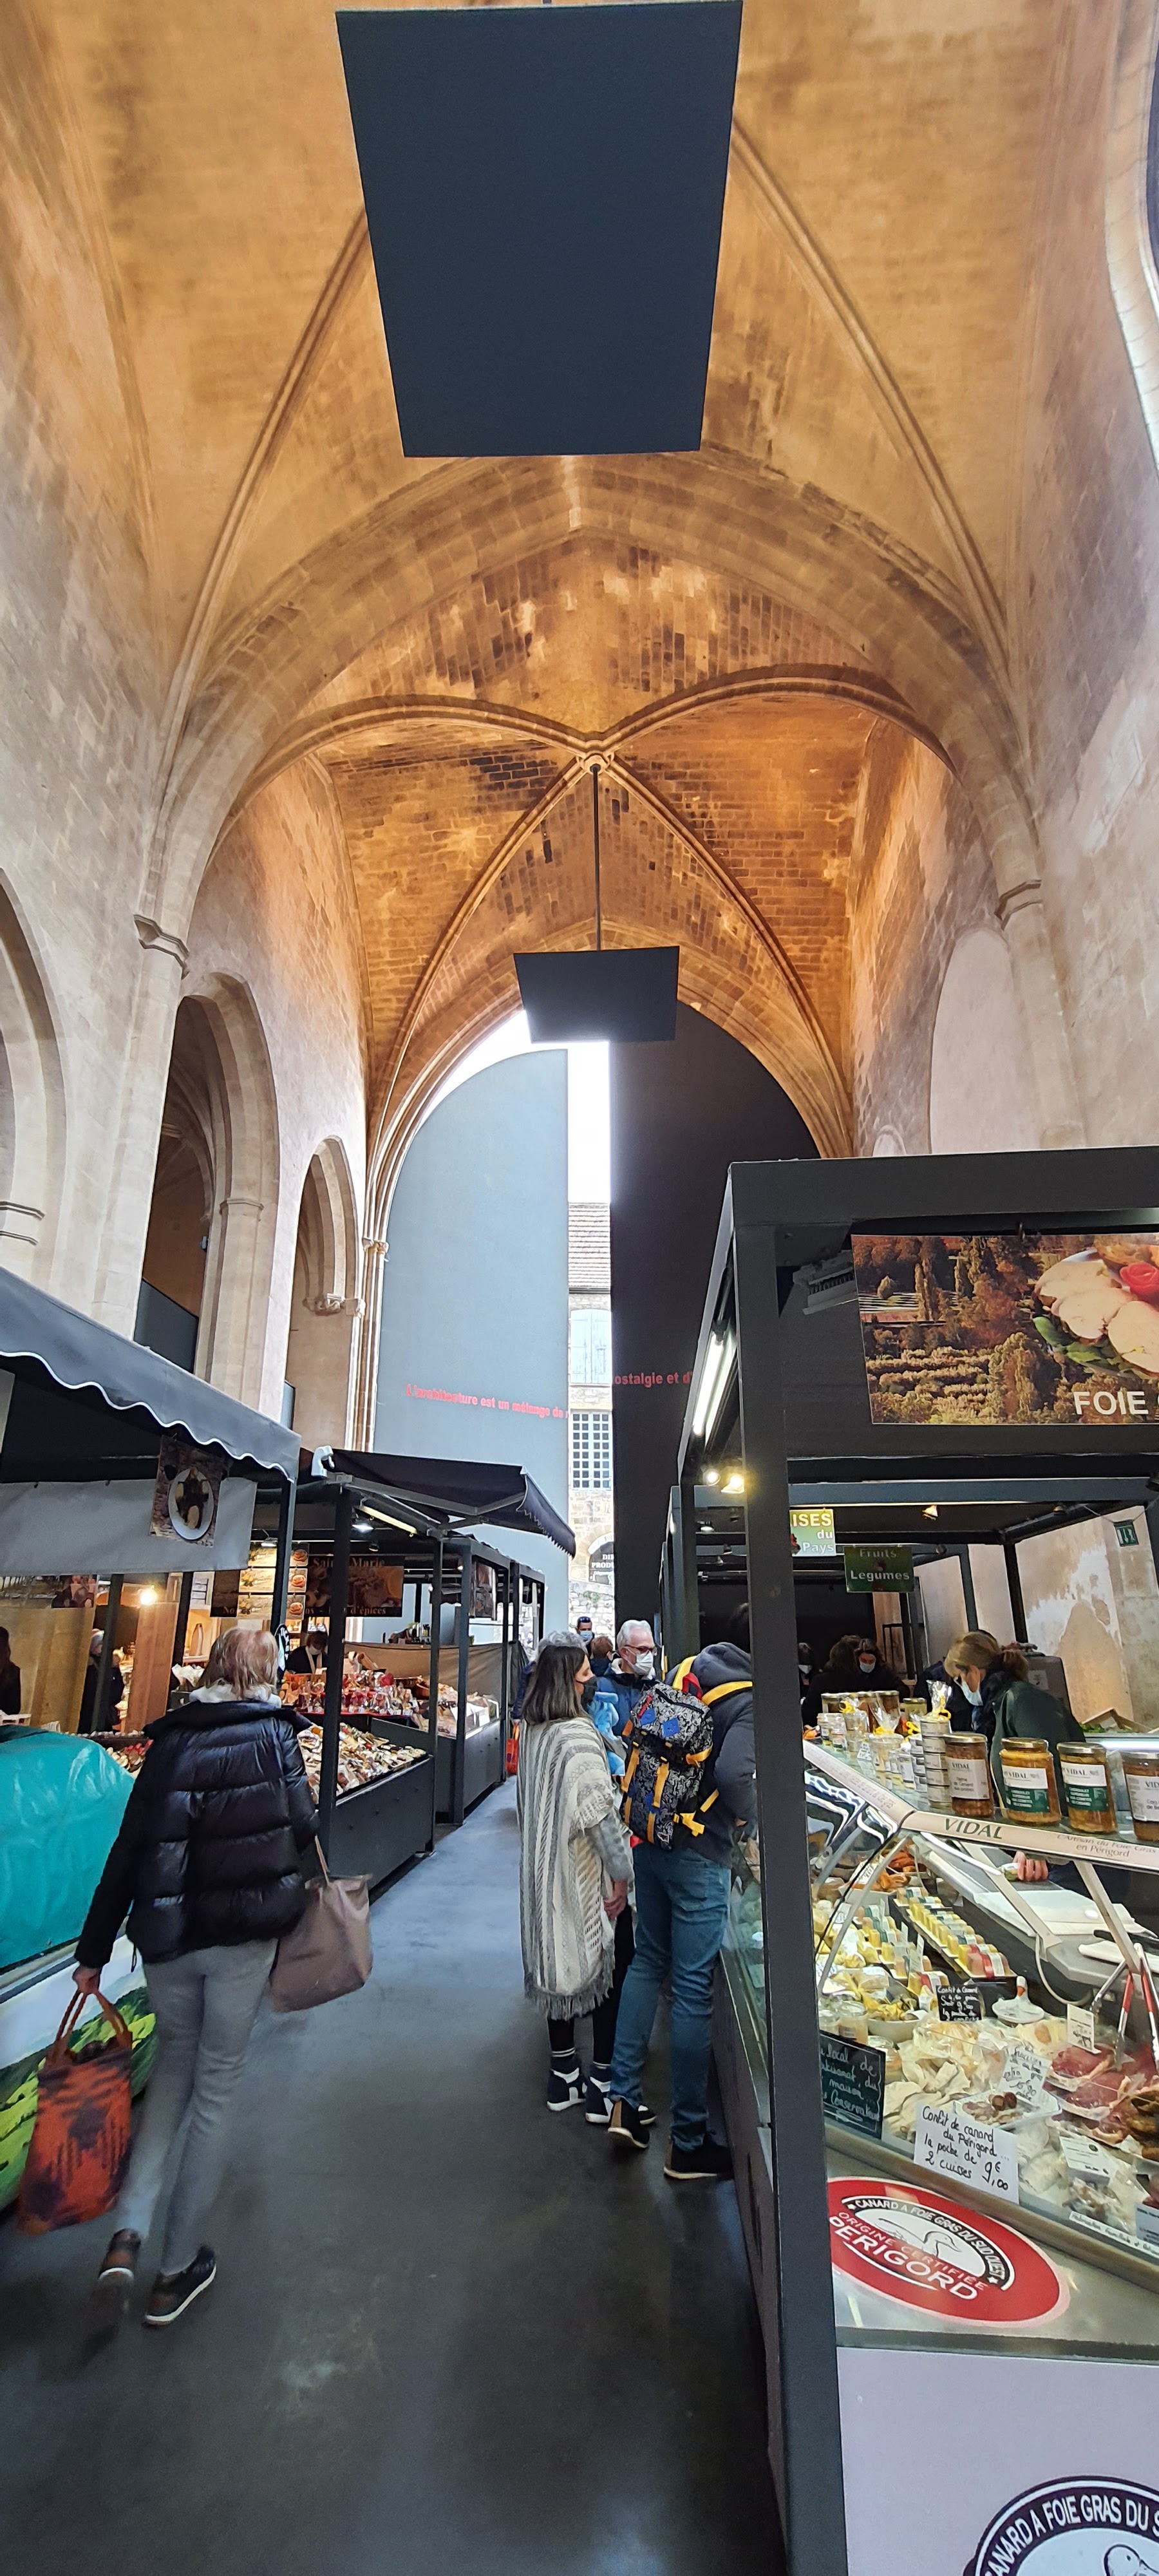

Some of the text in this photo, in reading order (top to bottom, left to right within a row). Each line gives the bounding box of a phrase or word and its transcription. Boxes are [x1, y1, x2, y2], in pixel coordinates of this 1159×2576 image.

[614, 1372, 663, 1388] ostalgie
[666, 1372, 679, 1385] et
[480, 1396, 495, 1408] est
[498, 1401, 509, 1410] un
[552, 1406, 563, 1419] de
[1073, 1391, 1149, 1415] FOIE
[793, 1513, 832, 1527] ISES
[817, 1529, 834, 1540] du
[802, 1542, 834, 1555] Pays
[859, 1548, 898, 1558] Fruits
[352, 1557, 385, 1567] Marie
[944, 1817, 1003, 1840] VIDAL
[1090, 1844, 1130, 1857] Périgord
[826, 2043, 877, 2077] local de
[865, 2075, 878, 2091] du
[922, 2105, 994, 2143] Confit de canard
[924, 2133, 977, 2164] la poche de
[943, 2128, 997, 2159] du Périgord
[925, 2150, 934, 2165] 2
[939, 2159, 972, 2179] cuisses
[838, 2211, 894, 2247] ORIGINE
[855, 2199, 899, 2210] CANARD
[910, 2207, 937, 2222] FOIE
[934, 2216, 963, 2233] GRAS
[957, 2228, 977, 2242] DU
[971, 2237, 992, 2256] SUD
[985, 2517, 1033, 2576] ANARD
[1029, 2508, 1046, 2537] A
[1042, 2495, 1082, 2530] FOIE
[1080, 2494, 1122, 2524] GRAS
[1126, 2499, 1149, 2531] DU
